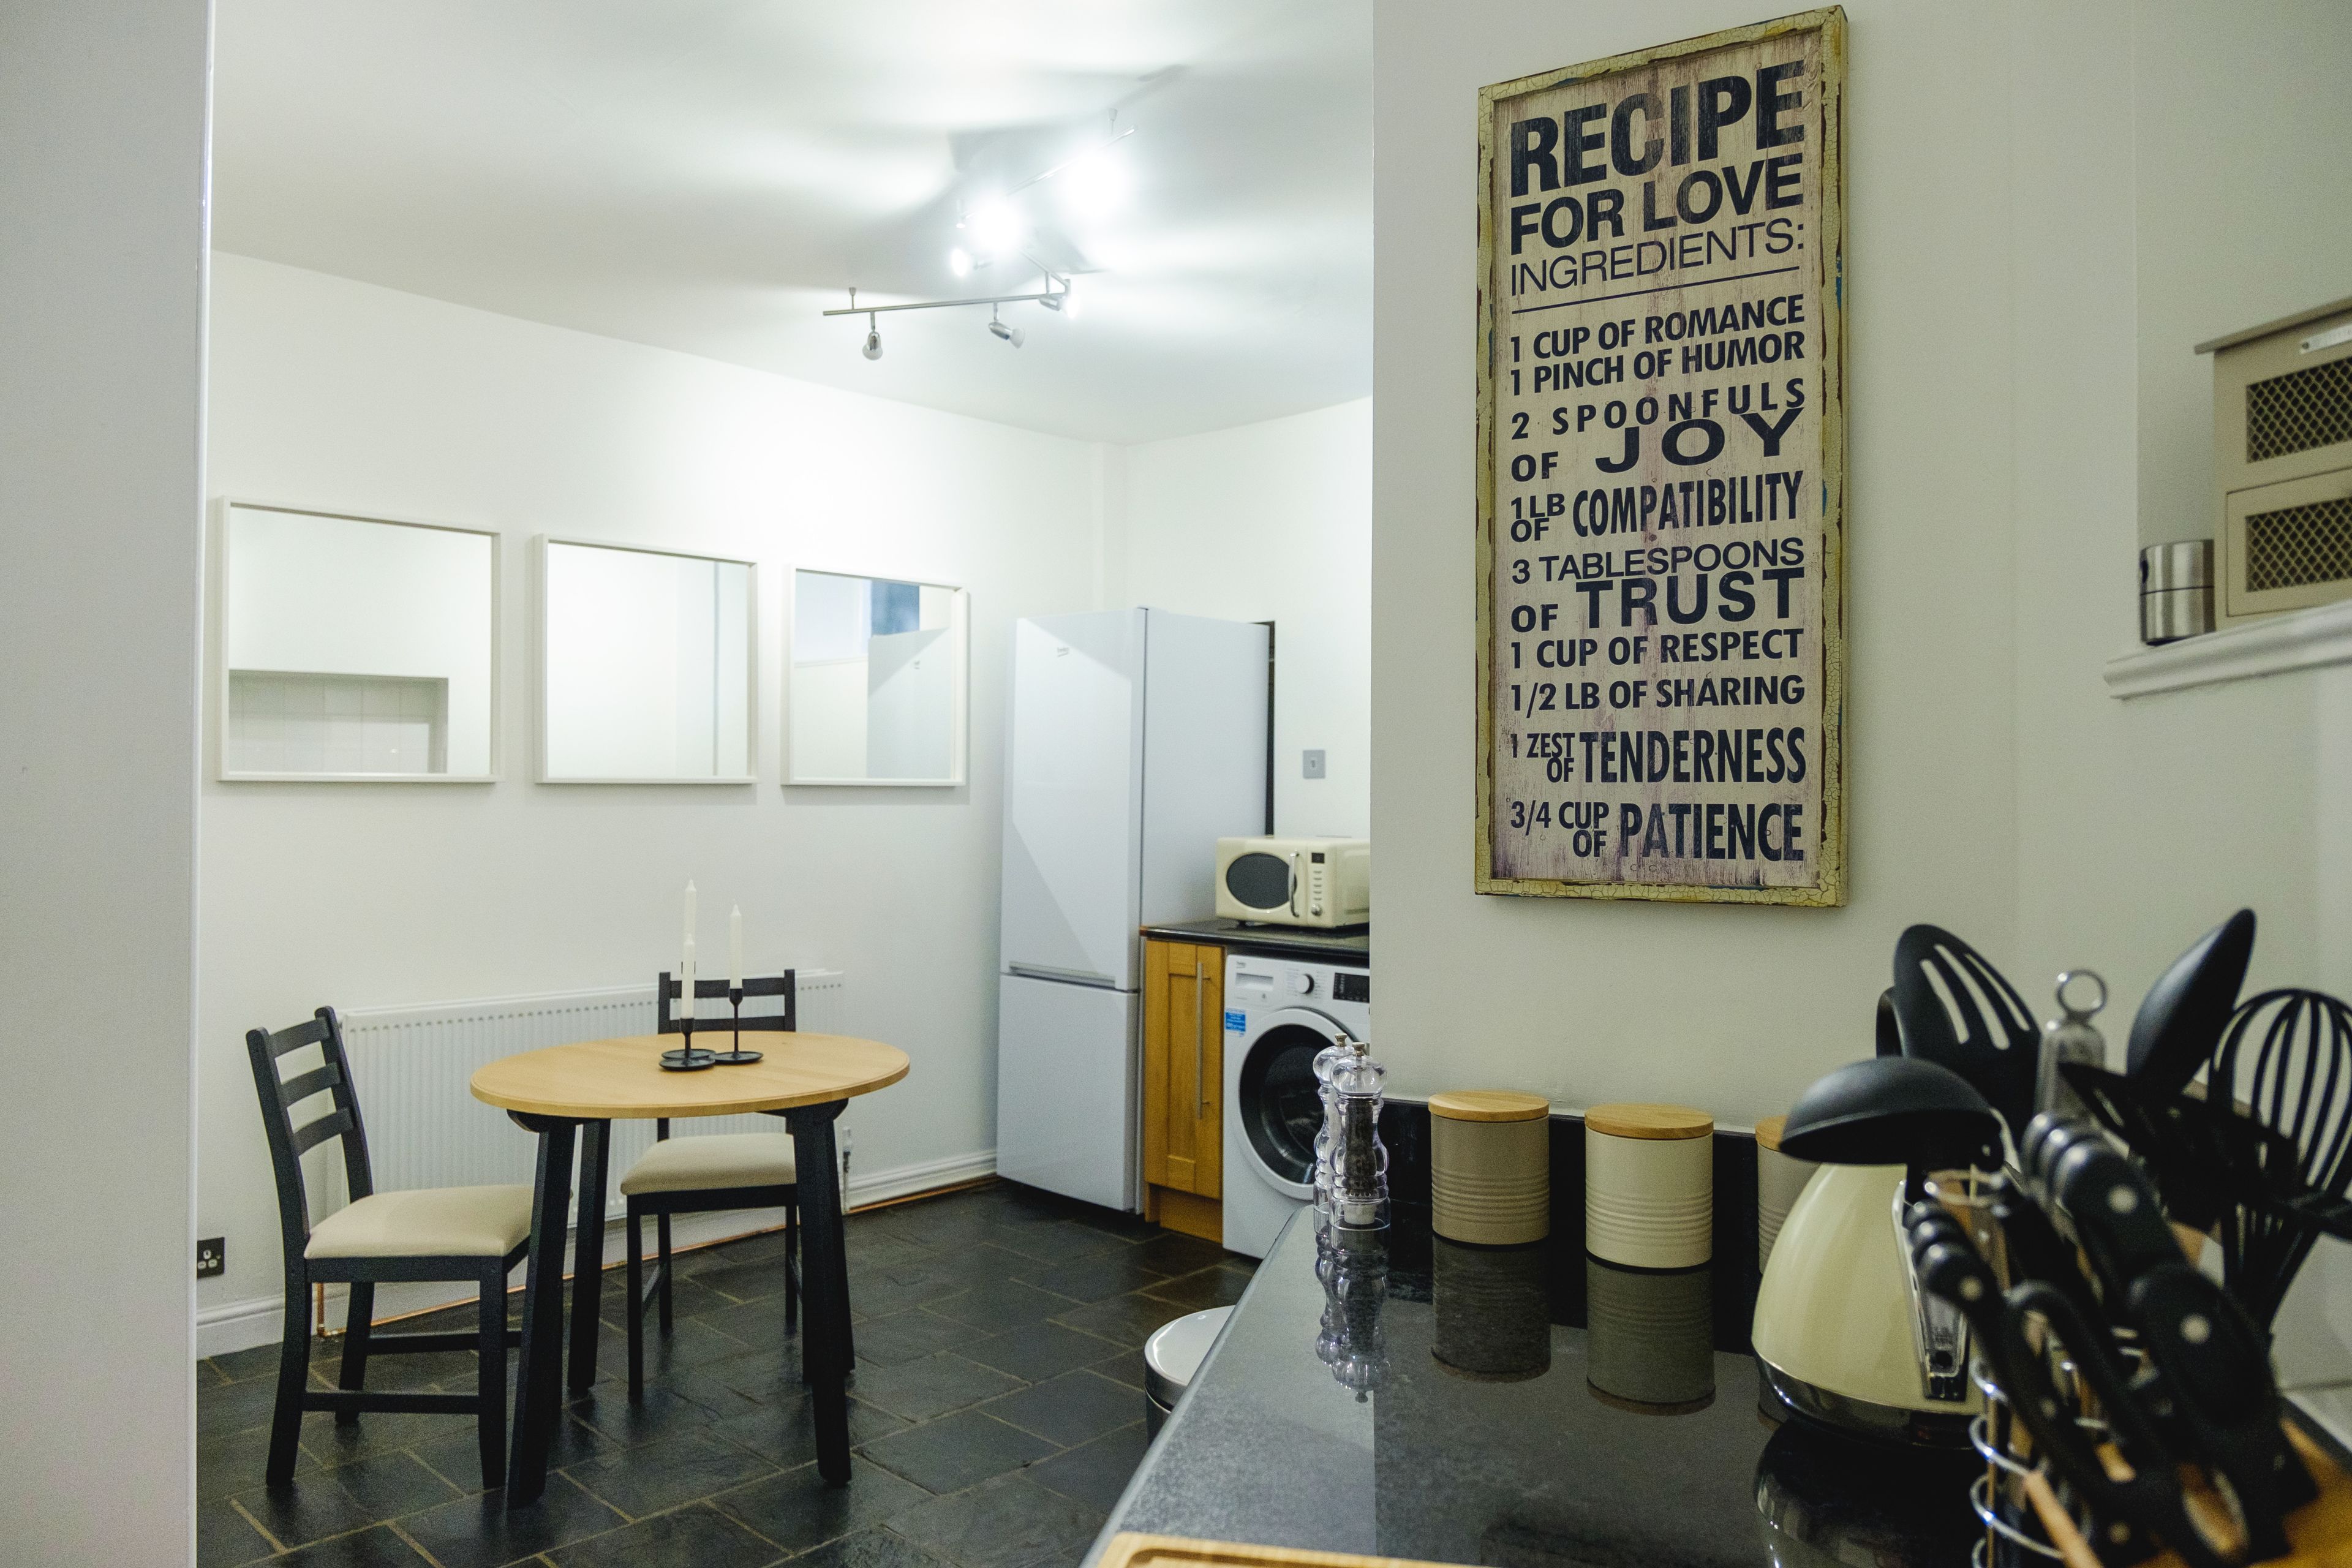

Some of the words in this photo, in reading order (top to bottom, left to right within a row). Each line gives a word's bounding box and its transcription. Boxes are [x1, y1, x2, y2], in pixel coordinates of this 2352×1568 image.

[1510, 60, 1804, 198] RECIPE
[1510, 188, 1624, 255] FOR
[1643, 153, 1803, 232] LOVE
[1512, 217, 1803, 296] INGREDIENTS:
[1511, 336, 1520, 363] 1
[1534, 326, 1590, 359] CUP
[1598, 319, 1635, 350] OF
[1645, 294, 1804, 344] ROMANCE
[1511, 369, 1520, 396] 1
[1534, 355, 1623, 393] PINCH
[1634, 349, 1672, 379] OF
[1682, 331, 1805, 374] HUMOR
[1511, 412, 1529, 439] 2
[1553, 378, 1805, 435] SPOONFULS
[1511, 451, 1559, 482] OF
[1595, 407, 1804, 473] JOY
[1510, 518, 1550, 543] OF
[1573, 470, 1803, 537] COMPATIBILITY
[1512, 559, 1530, 584] 3
[1539, 537, 1804, 581] TABLESPOONS
[1511, 604, 1558, 633] OF
[1575, 567, 1804, 628] TRUST
[1511, 642, 1520, 669] 1
[1537, 639, 1597, 668] CUP
[1608, 636, 1648, 666] OF
[1660, 628, 1803, 663] RESPECT
[1511, 683, 1556, 718] 1/2
[1566, 682, 1599, 710] LB
[1609, 680, 1648, 709] OF
[1656, 675, 1805, 707] SHARING
[1510, 734, 1518, 758] 1
[1527, 732, 1575, 758] ZEST
[1547, 757, 1574, 783] OF
[1580, 727, 1806, 783] TENDERNESS
[1510, 801, 1551, 835] 3/4
[1559, 802, 1609, 829] CUP
[1573, 830, 1607, 857] OF
[1621, 803, 1804, 861] PATIENCE
